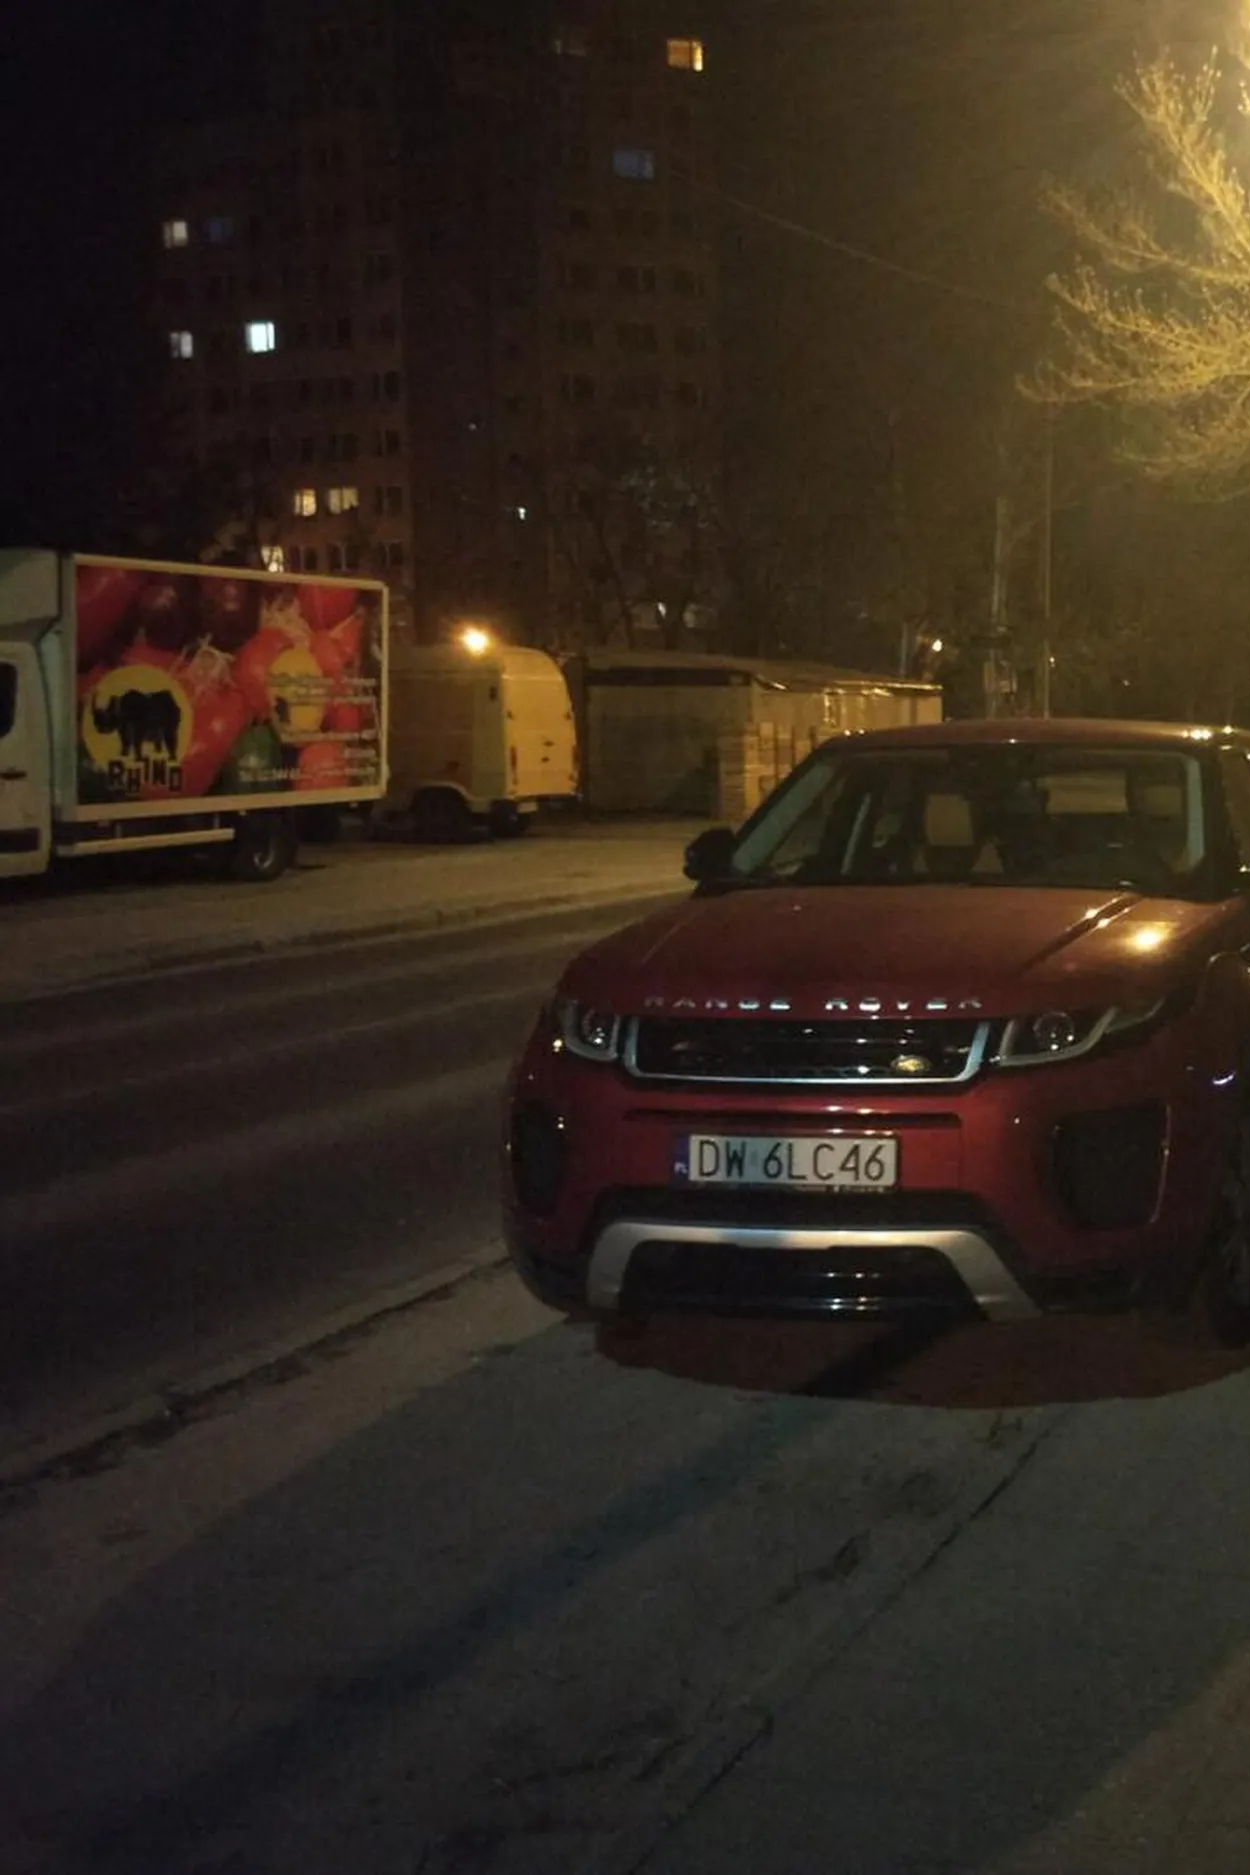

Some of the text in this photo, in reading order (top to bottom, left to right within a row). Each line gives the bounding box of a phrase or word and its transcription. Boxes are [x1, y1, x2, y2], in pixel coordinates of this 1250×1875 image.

[108, 757, 182, 792] RHINO
[698, 1139, 886, 1182] DW 6LC46
